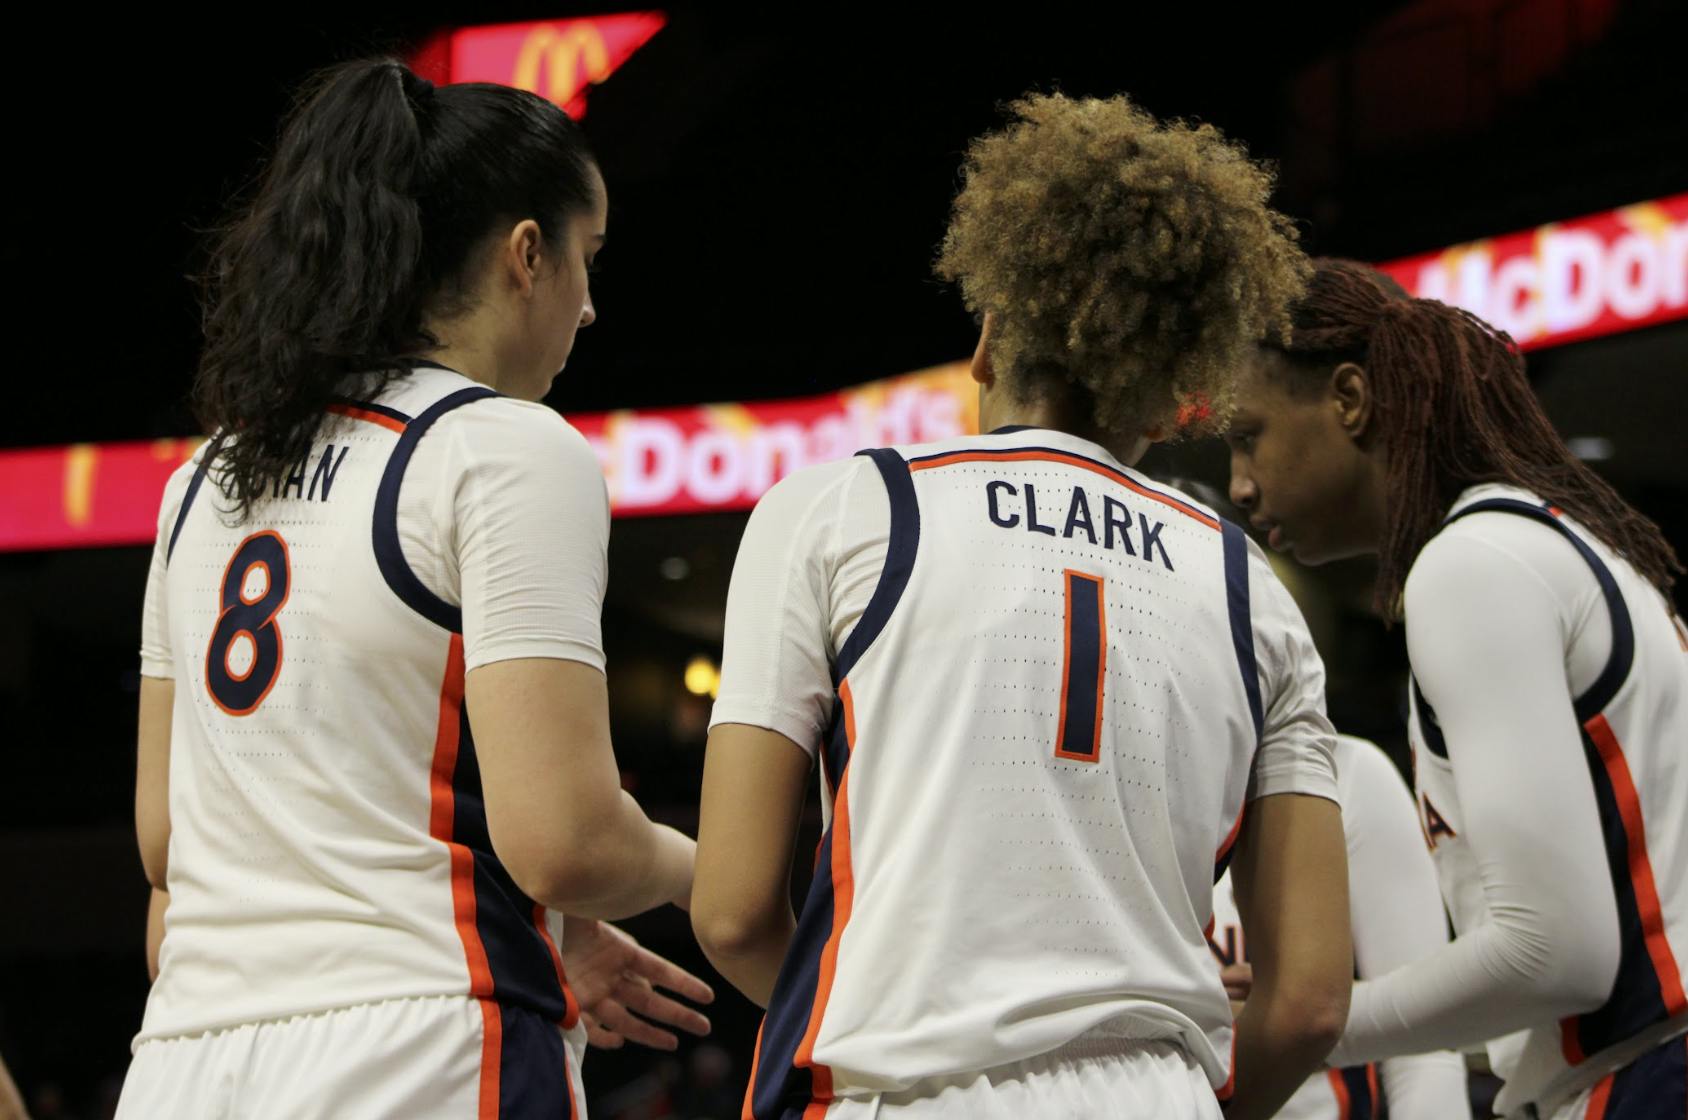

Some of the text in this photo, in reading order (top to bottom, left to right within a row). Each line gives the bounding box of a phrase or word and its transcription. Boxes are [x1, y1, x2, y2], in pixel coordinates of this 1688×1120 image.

[986, 480, 1175, 572] CLARK
[205, 529, 291, 717] 8
[1054, 568, 1107, 764] 1
